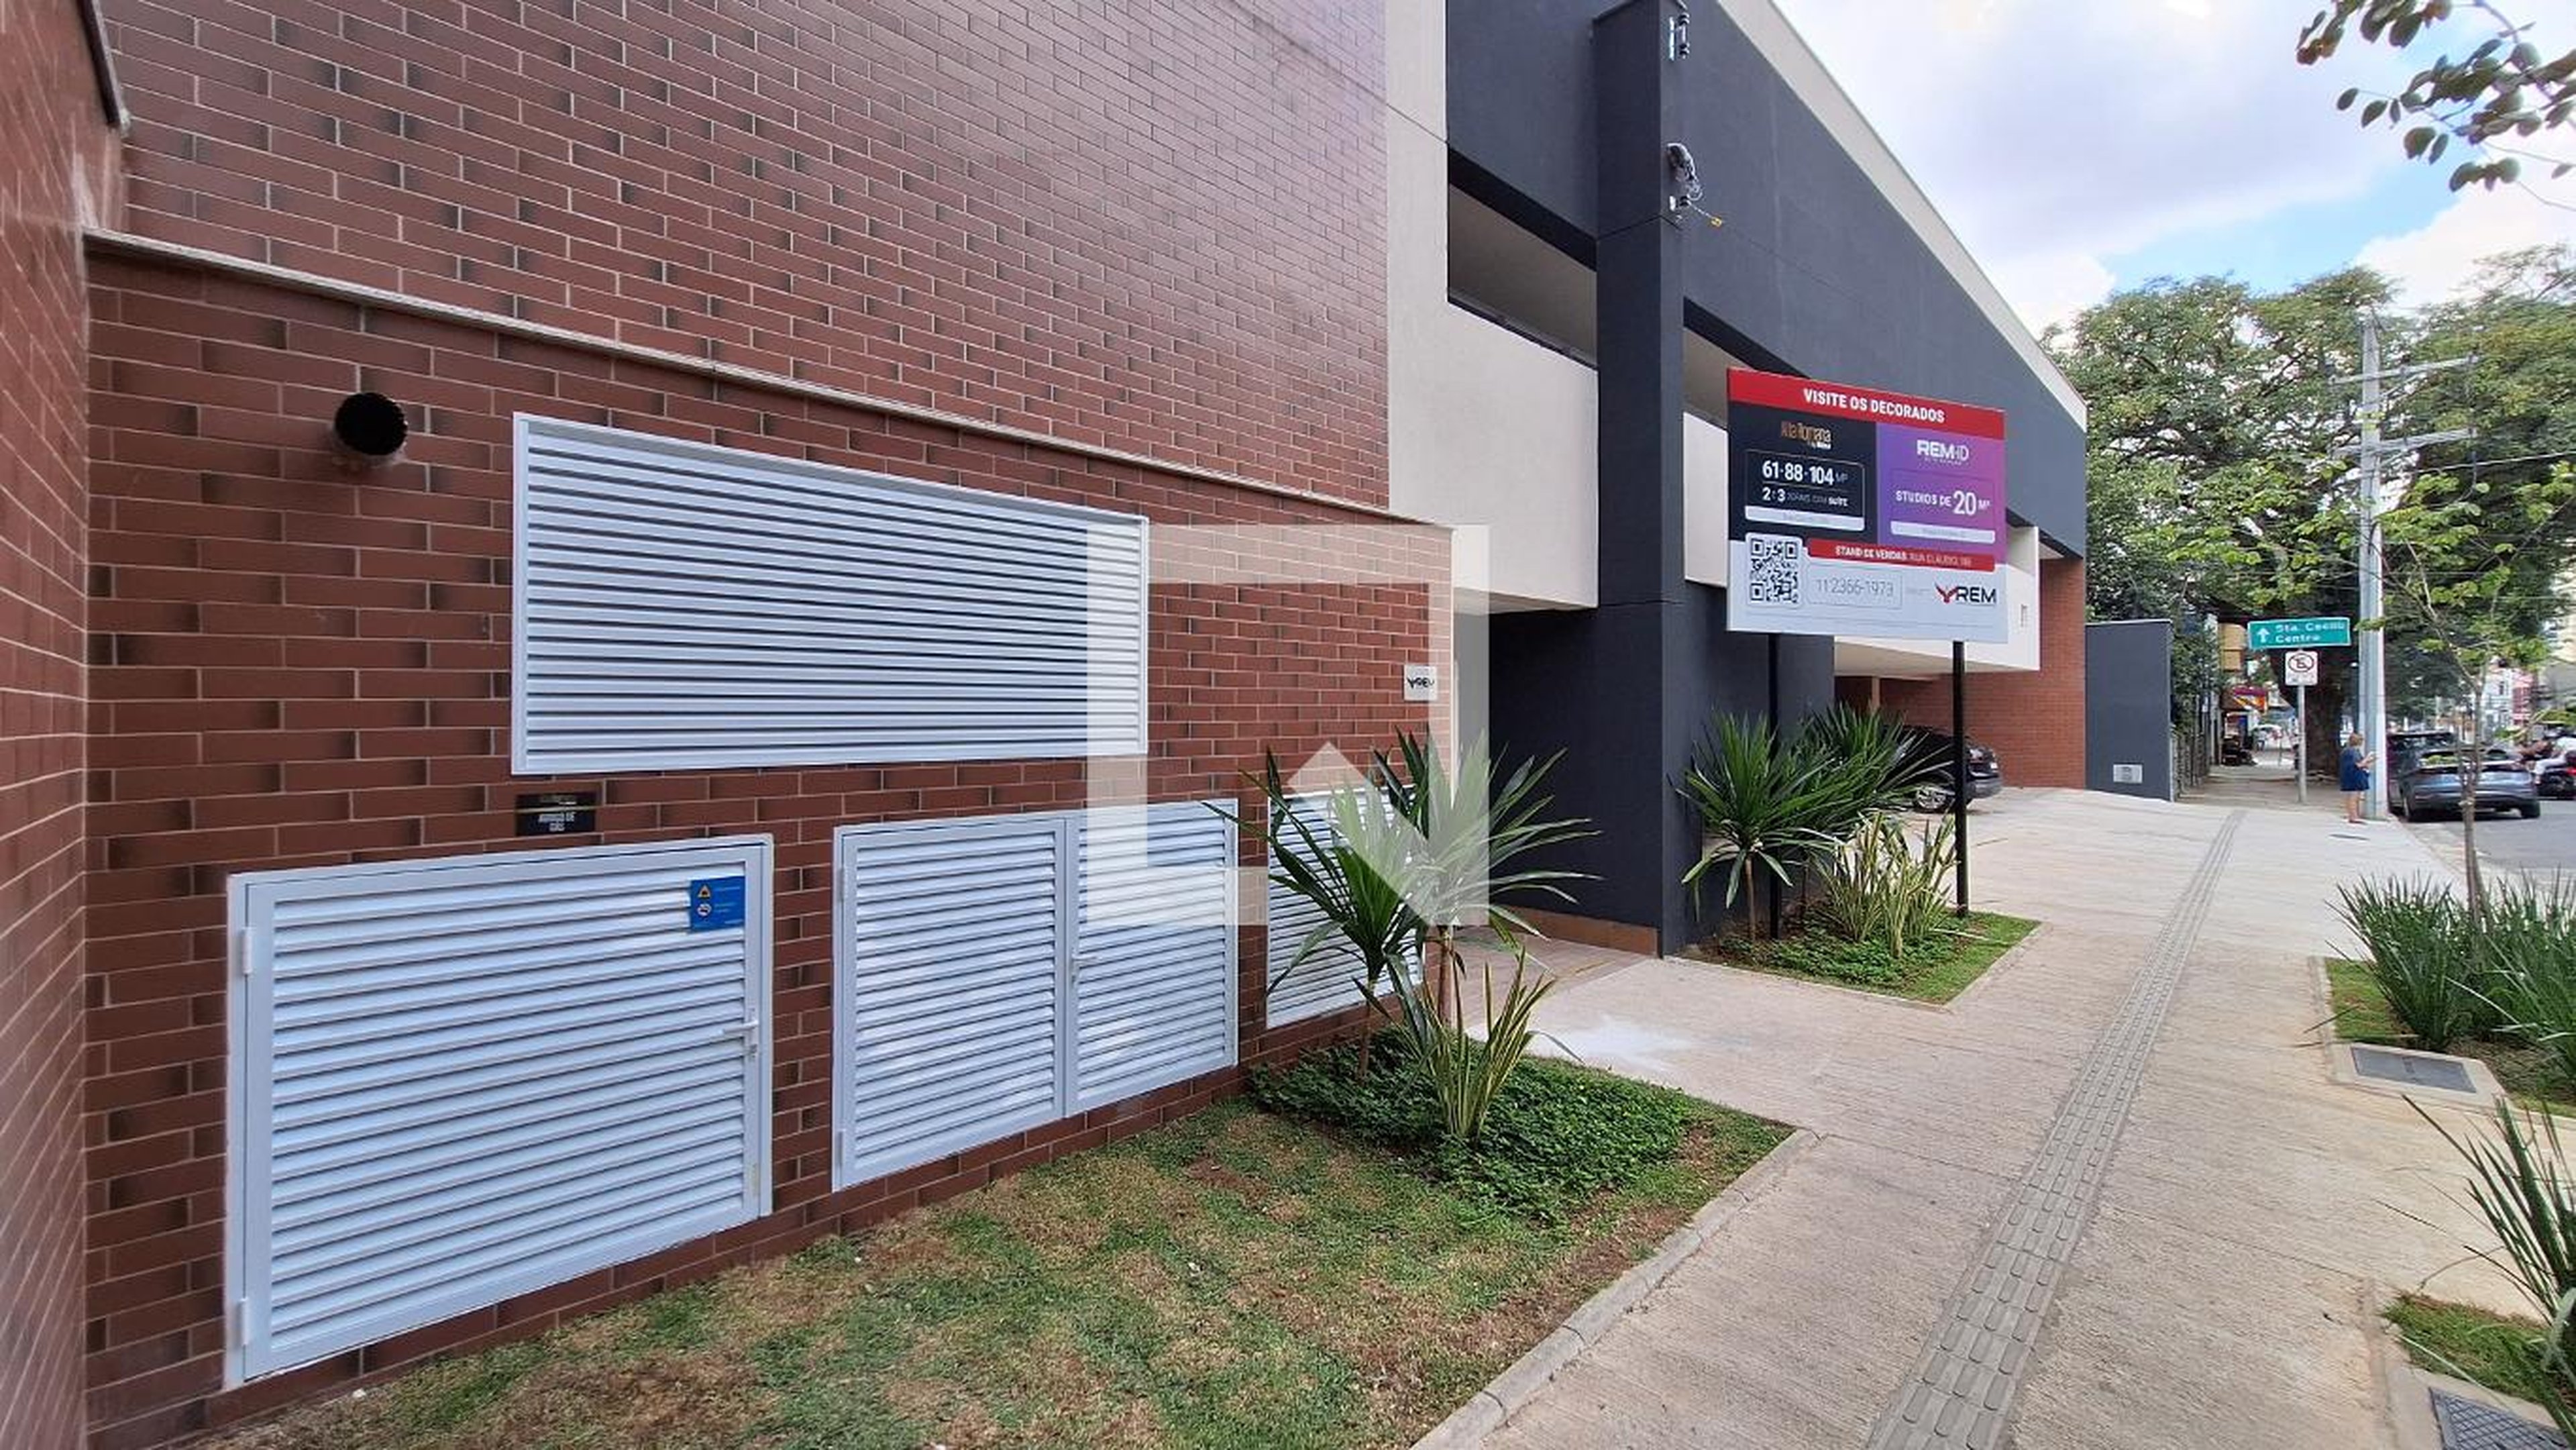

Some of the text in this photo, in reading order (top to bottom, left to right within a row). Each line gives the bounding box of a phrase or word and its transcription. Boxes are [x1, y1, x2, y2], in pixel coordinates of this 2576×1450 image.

[1803, 388, 1945, 423] VISITE OS DECORADOS
[1762, 486, 1771, 501] 2
[1777, 488, 1786, 502] 3
[1896, 490, 1937, 505] STUDIOS
[1939, 496, 1951, 507] DE
[1953, 490, 1977, 516] 20
[2275, 634, 2321, 643] Centro
